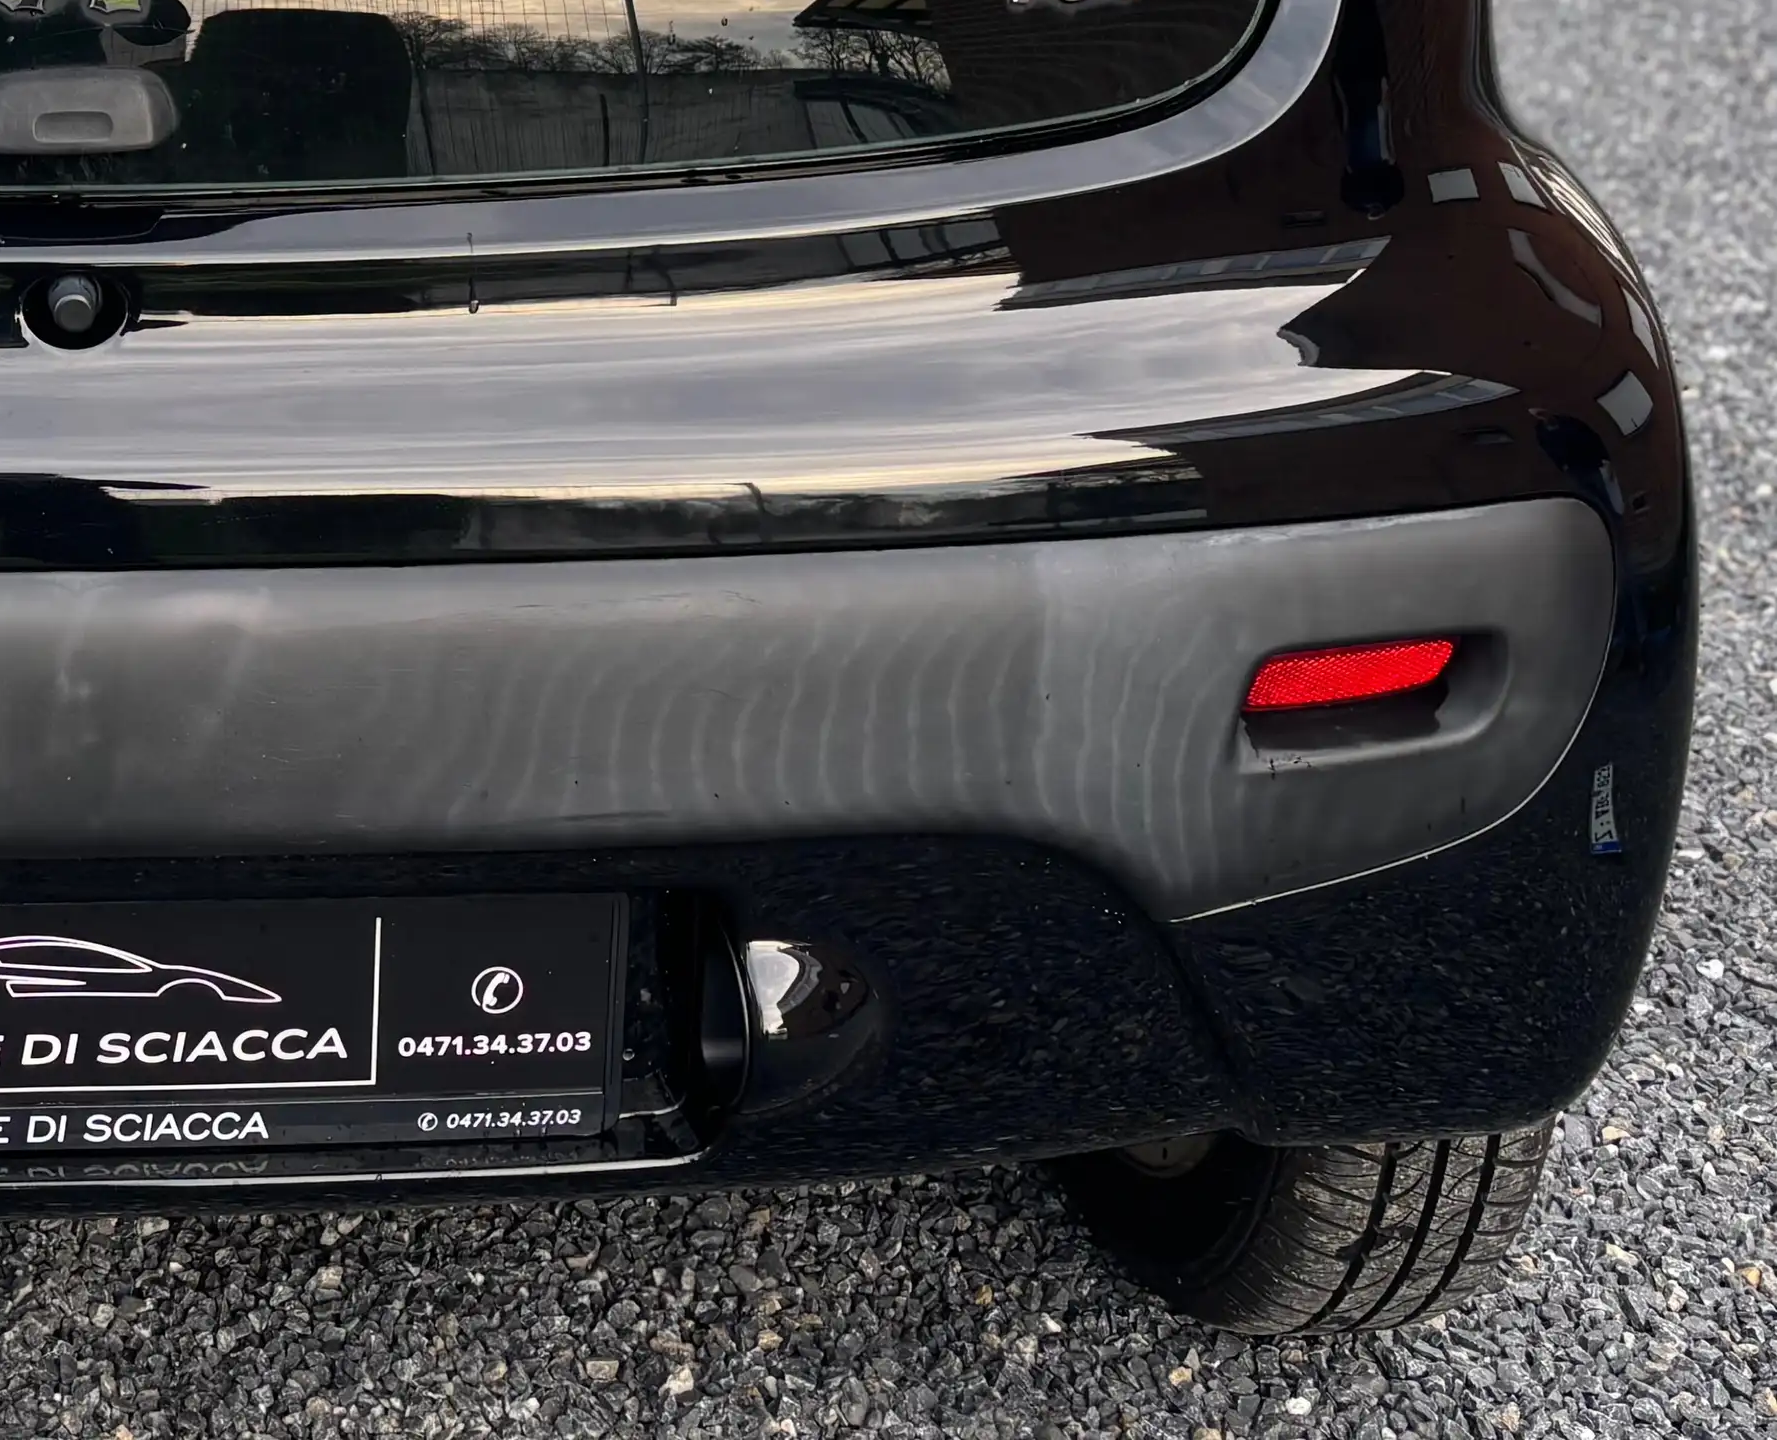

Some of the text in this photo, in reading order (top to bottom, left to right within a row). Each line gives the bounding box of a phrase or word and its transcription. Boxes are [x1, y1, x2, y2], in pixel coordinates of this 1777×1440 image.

[21, 1033, 79, 1066] DI
[96, 1027, 348, 1064] SCIACCA
[397, 1031, 592, 1058] 0471.34.37.03
[26, 1114, 68, 1144] DI
[82, 1111, 270, 1143] SCIACCA
[445, 1108, 582, 1129] 0471.34.37.03
